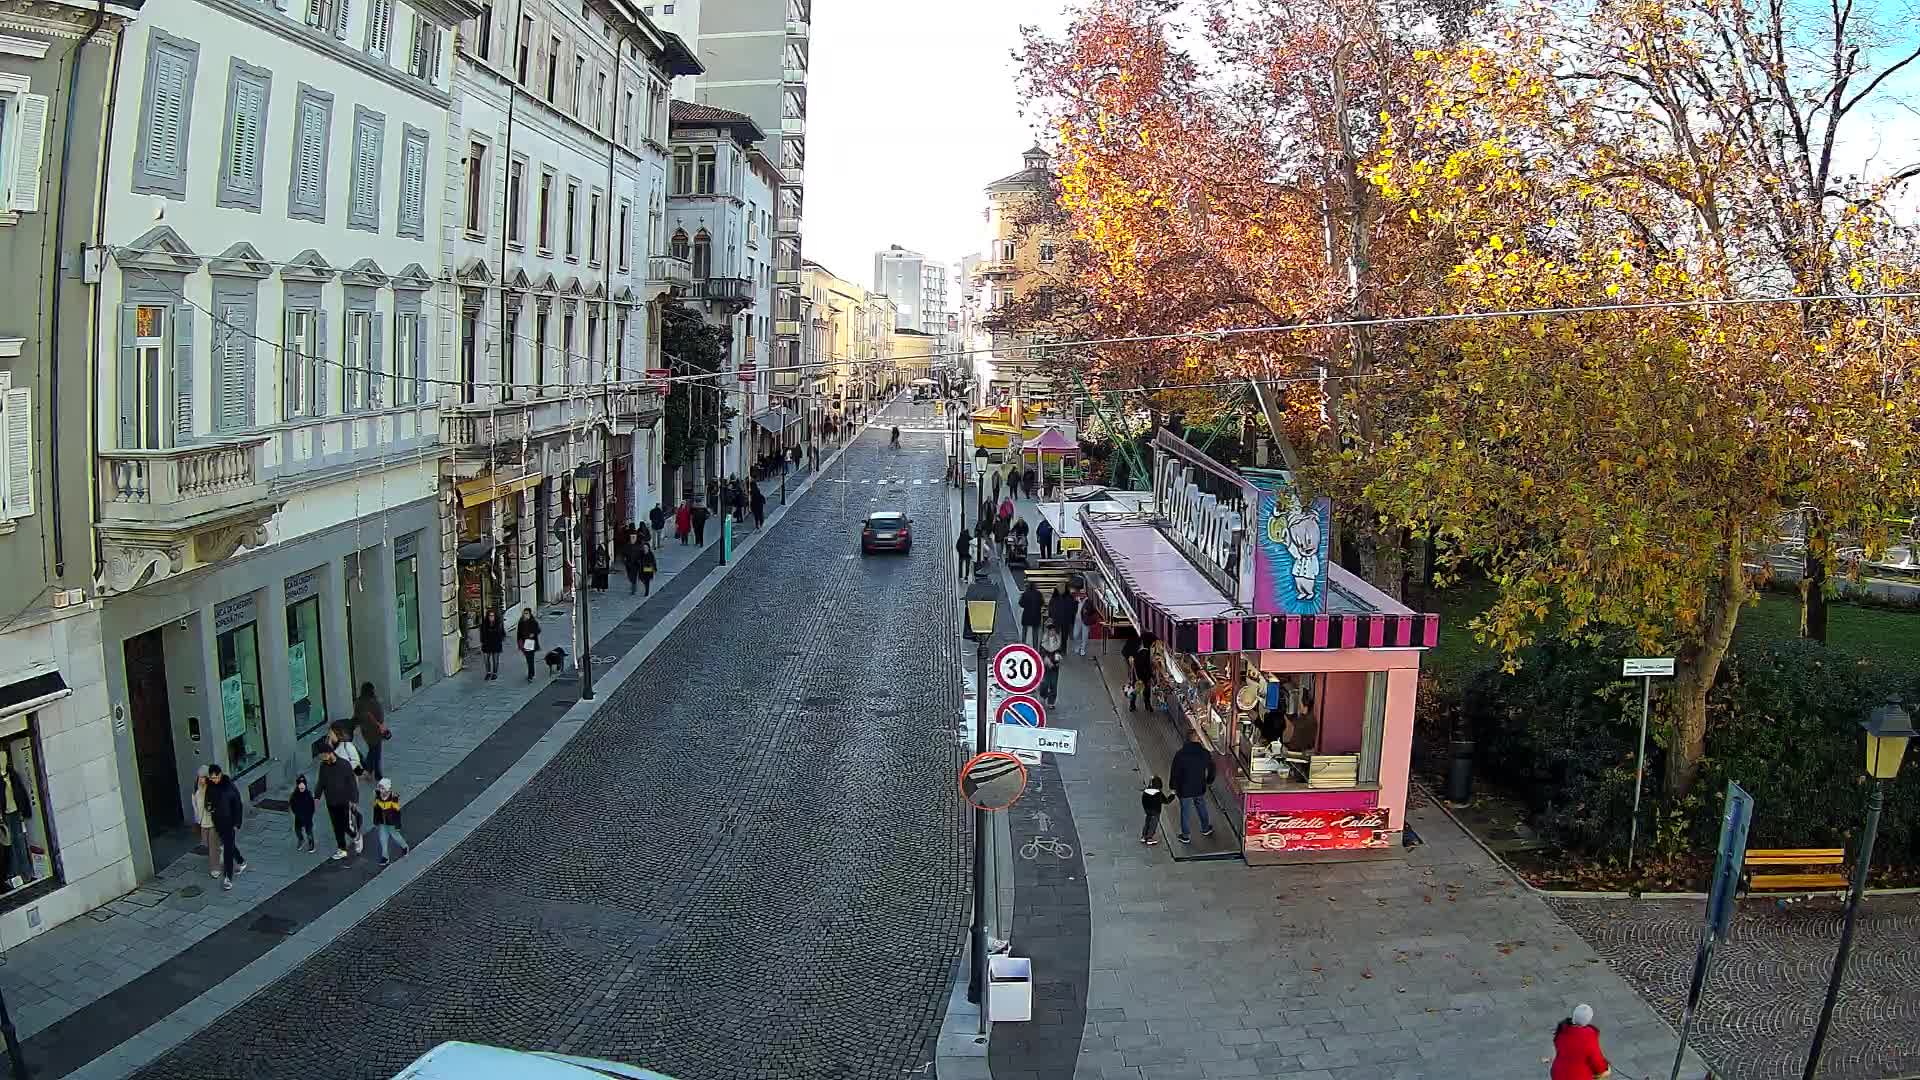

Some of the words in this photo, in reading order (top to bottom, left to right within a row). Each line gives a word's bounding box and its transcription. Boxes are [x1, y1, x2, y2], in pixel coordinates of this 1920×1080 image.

[1006, 658, 1032, 680] 30
[1038, 737, 1069, 749] Dante
[1331, 814, 1383, 829] Calde
